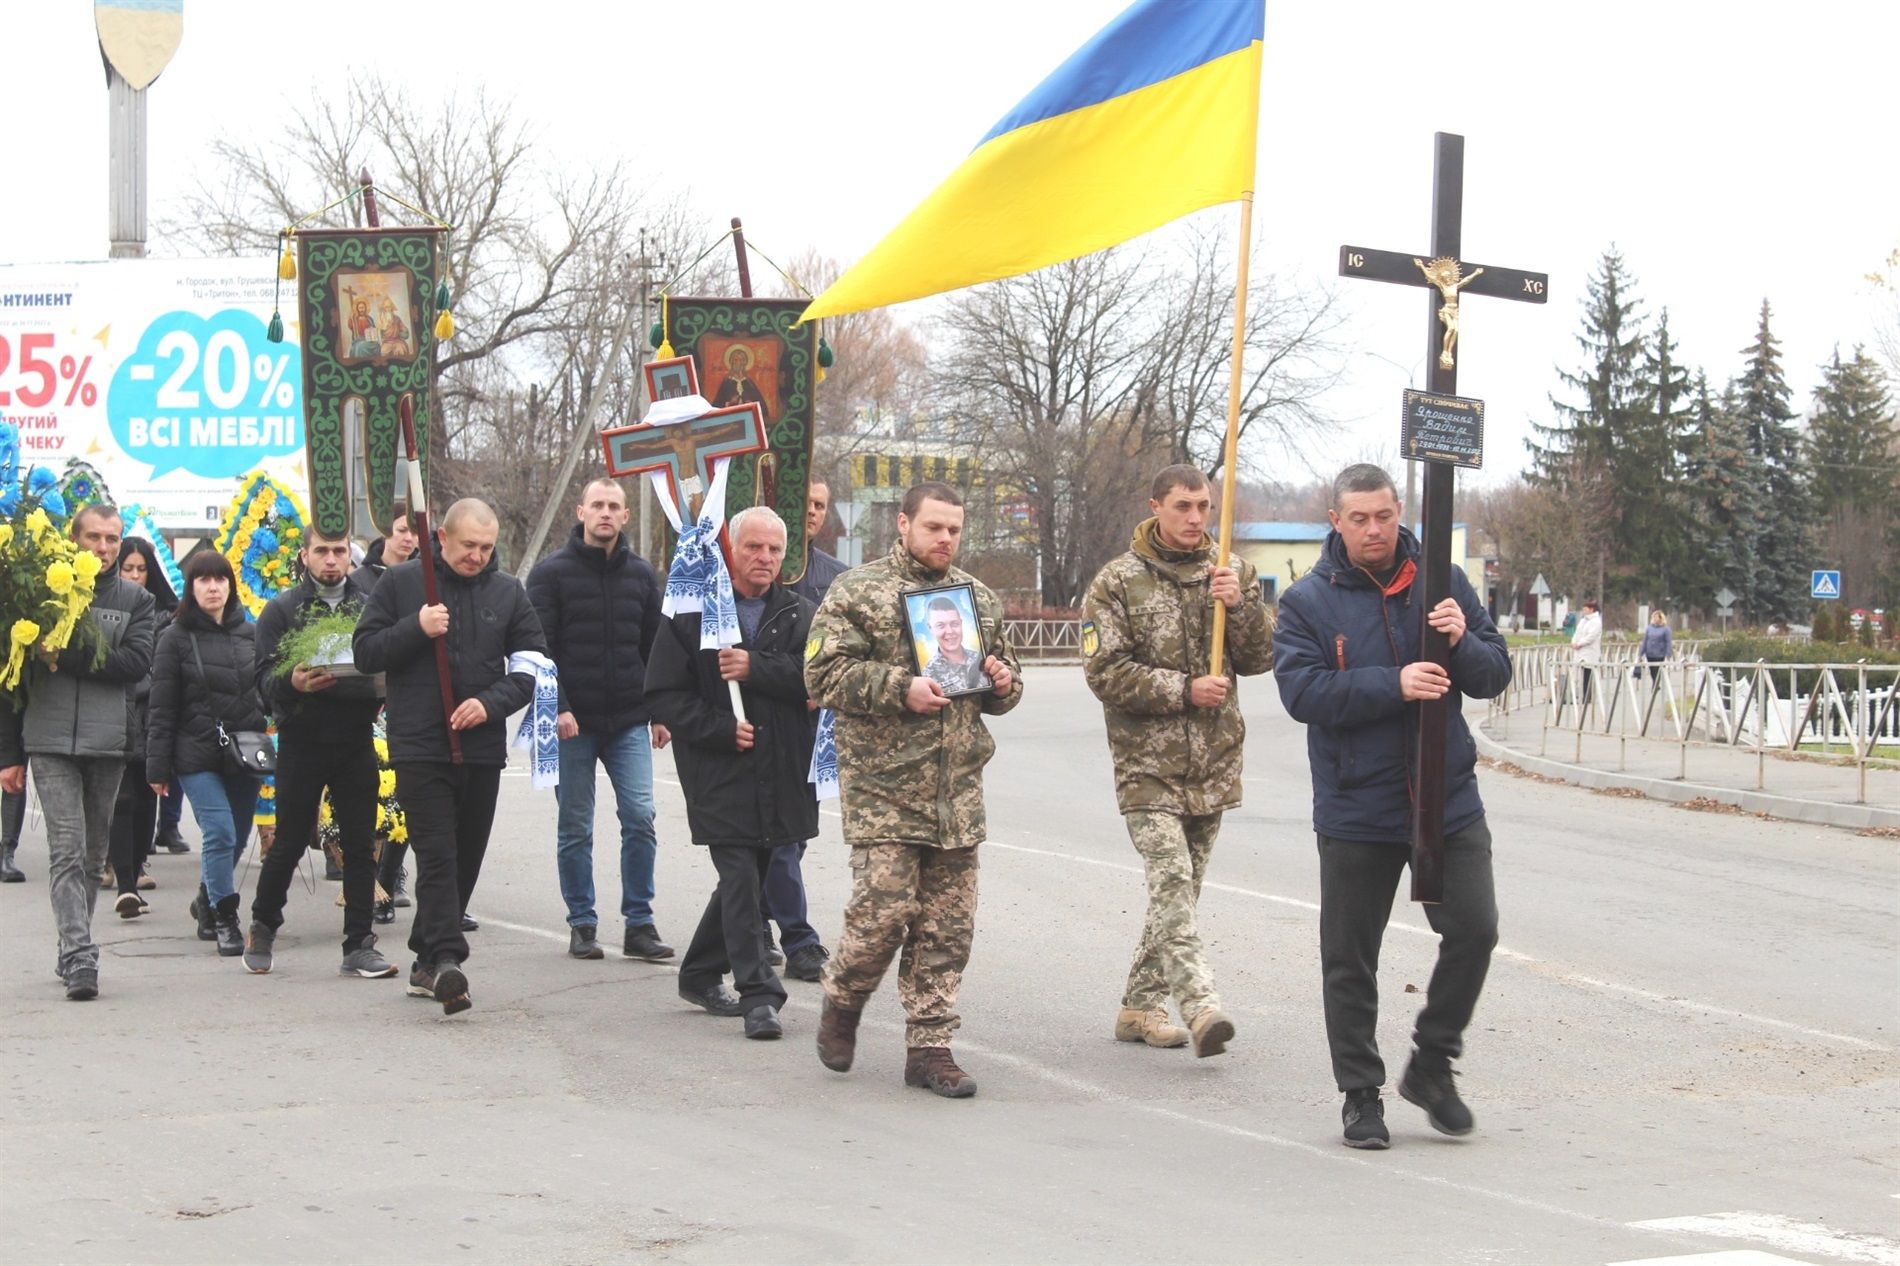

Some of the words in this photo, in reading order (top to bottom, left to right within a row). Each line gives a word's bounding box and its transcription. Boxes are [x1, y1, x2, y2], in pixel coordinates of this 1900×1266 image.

[186, 276, 218, 287] Городок,
[0, 292, 73, 307] НТИНЕНТ
[130, 329, 294, 409] -20%
[129, 417, 179, 447] ВСІ
[190, 415, 295, 447] МЕБЛІ
[1422, 420, 1468, 435] Вадим
[26, 436, 64, 450] ЧЕКУ
